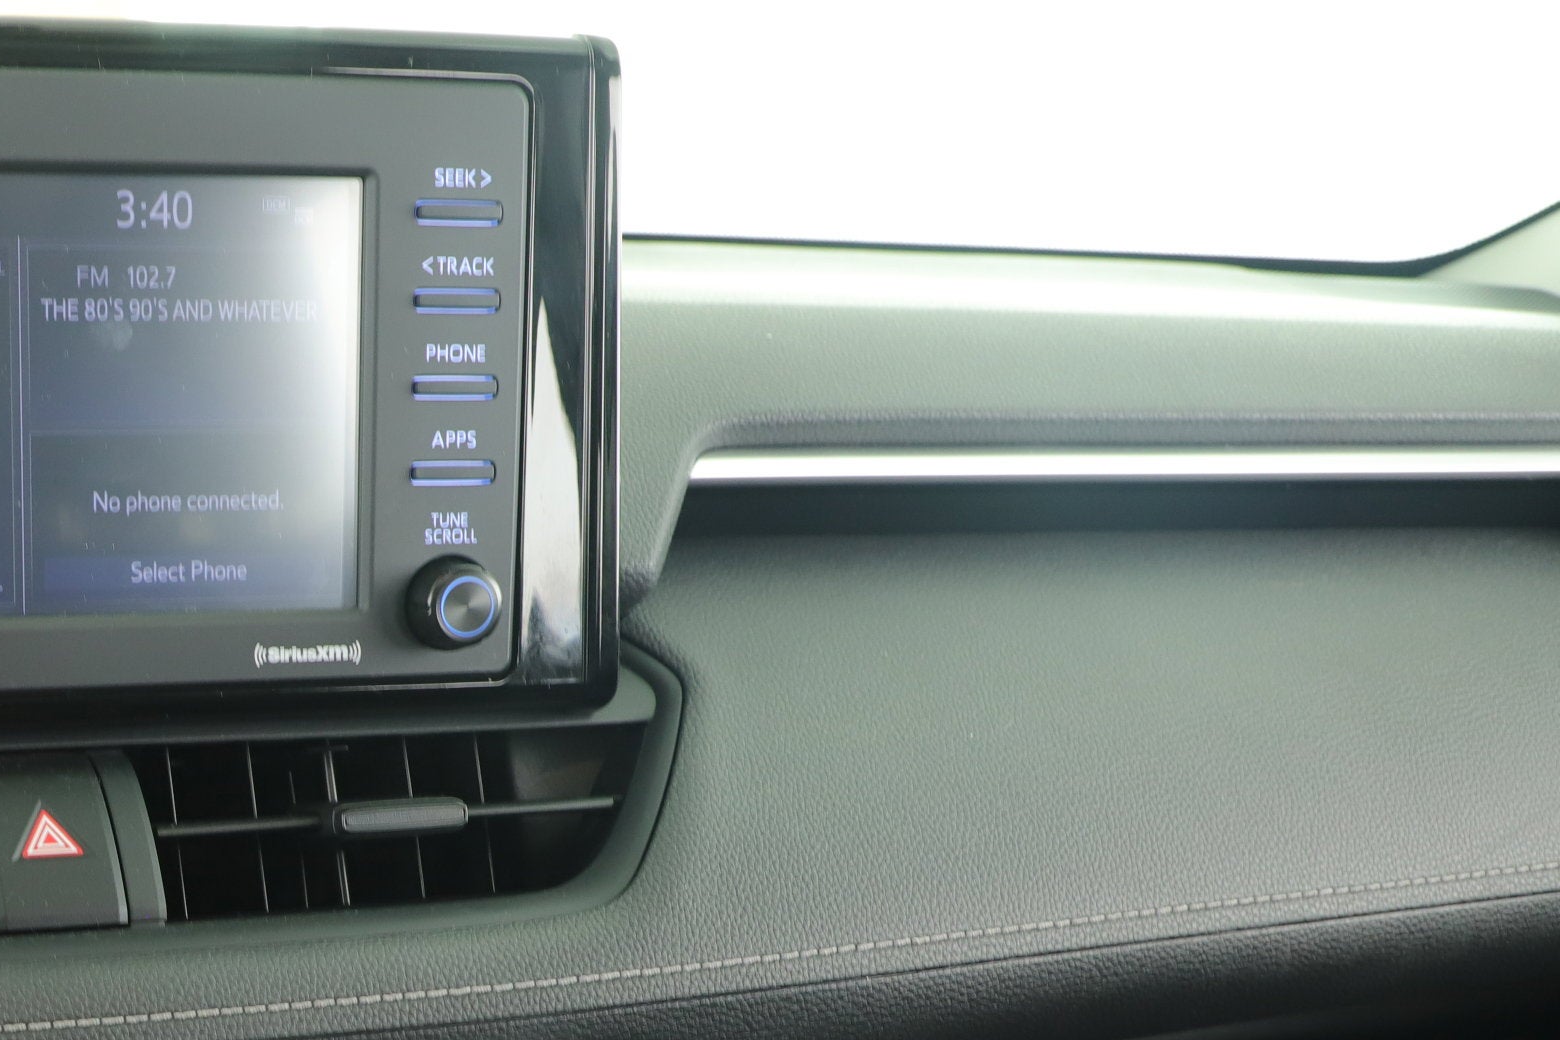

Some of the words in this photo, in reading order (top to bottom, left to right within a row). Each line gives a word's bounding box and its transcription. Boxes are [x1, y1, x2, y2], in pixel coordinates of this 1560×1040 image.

[434, 167, 476, 188] SEEK
[116, 190, 194, 230] 3:40
[436, 256, 494, 276] TRACK
[77, 266, 109, 289] FM
[127, 265, 176, 290] 102.7
[41, 298, 79, 322] THE
[84, 298, 124, 322] 80'S
[128, 299, 168, 322] 90'S
[172, 299, 214, 322] AND
[217, 300, 319, 323] WHATEVER
[426, 344, 486, 363] PHONE
[431, 430, 477, 449] APPS
[92, 491, 121, 514] No
[126, 491, 182, 517] phone
[187, 489, 284, 513] connected.
[431, 512, 470, 529] TUNE
[424, 528, 478, 546] SCROLL
[130, 559, 186, 584] Select
[191, 559, 248, 582] Phone
